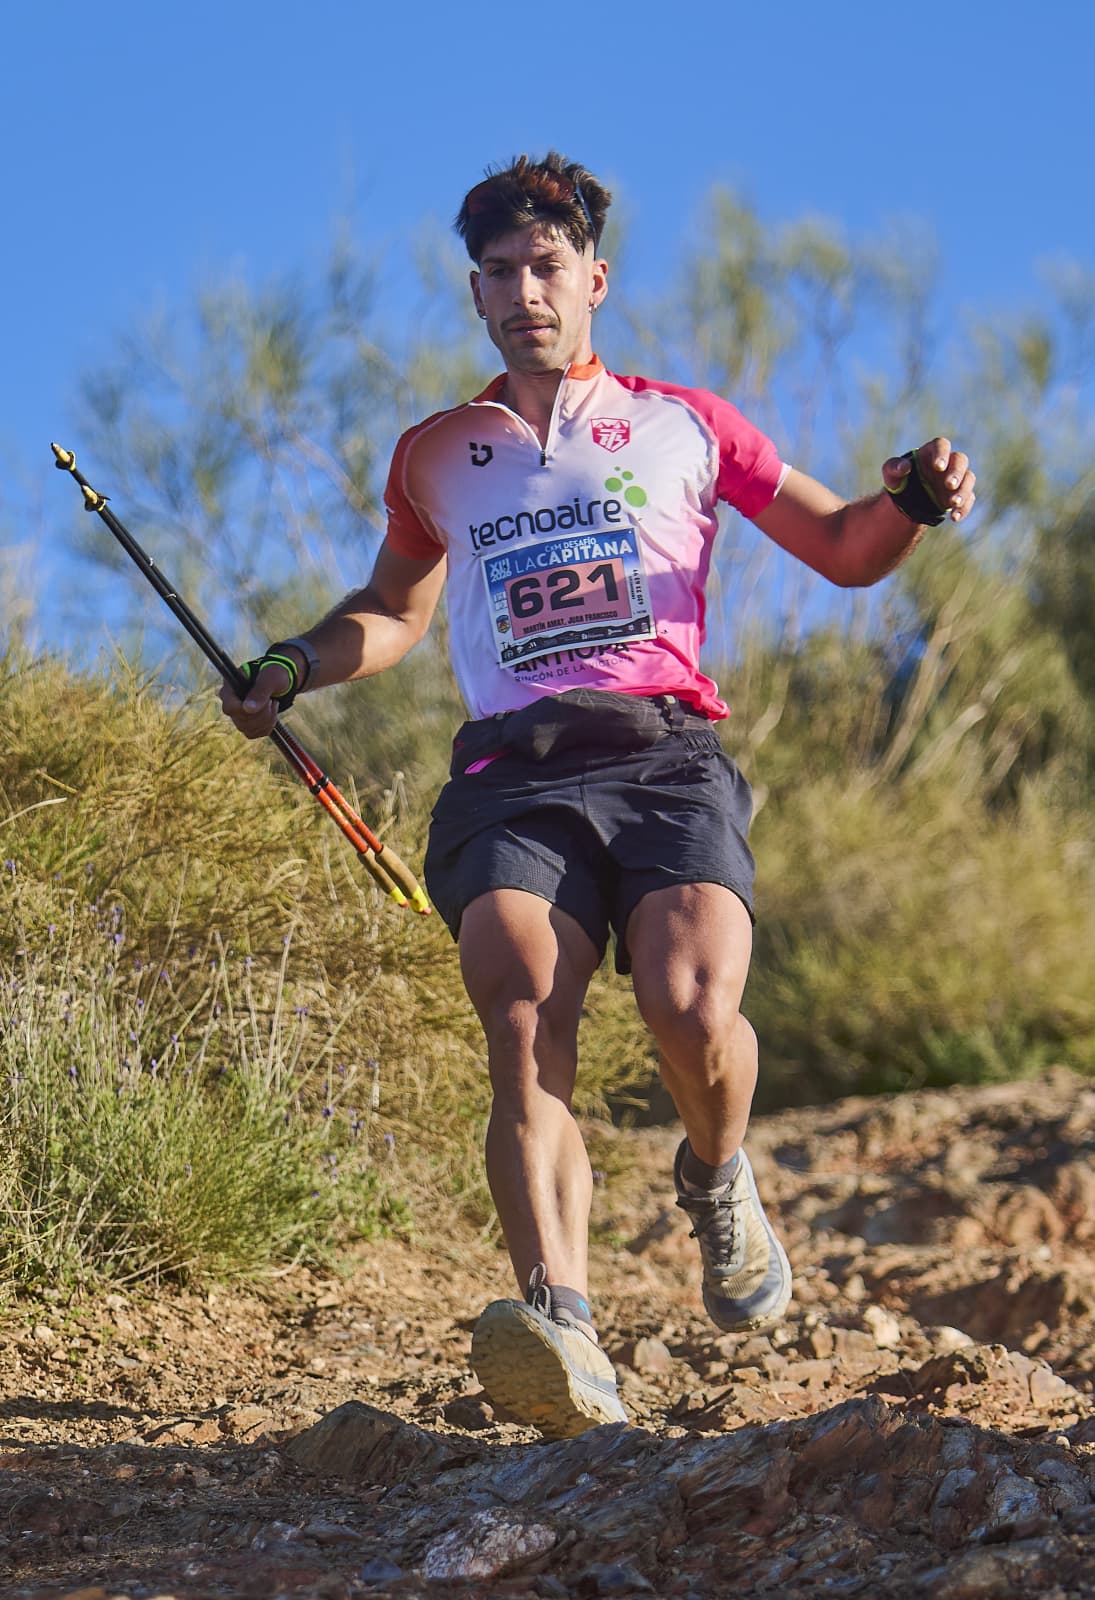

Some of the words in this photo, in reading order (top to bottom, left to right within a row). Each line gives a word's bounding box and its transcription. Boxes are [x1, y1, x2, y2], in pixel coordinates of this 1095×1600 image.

[469, 498, 621, 550] tecnoaire
[564, 537, 596, 548] DESAFÍO
[510, 564, 619, 618] 621
[556, 667, 570, 677] DE
[573, 663, 586, 673] LA
[587, 656, 634, 669] VICTORI
